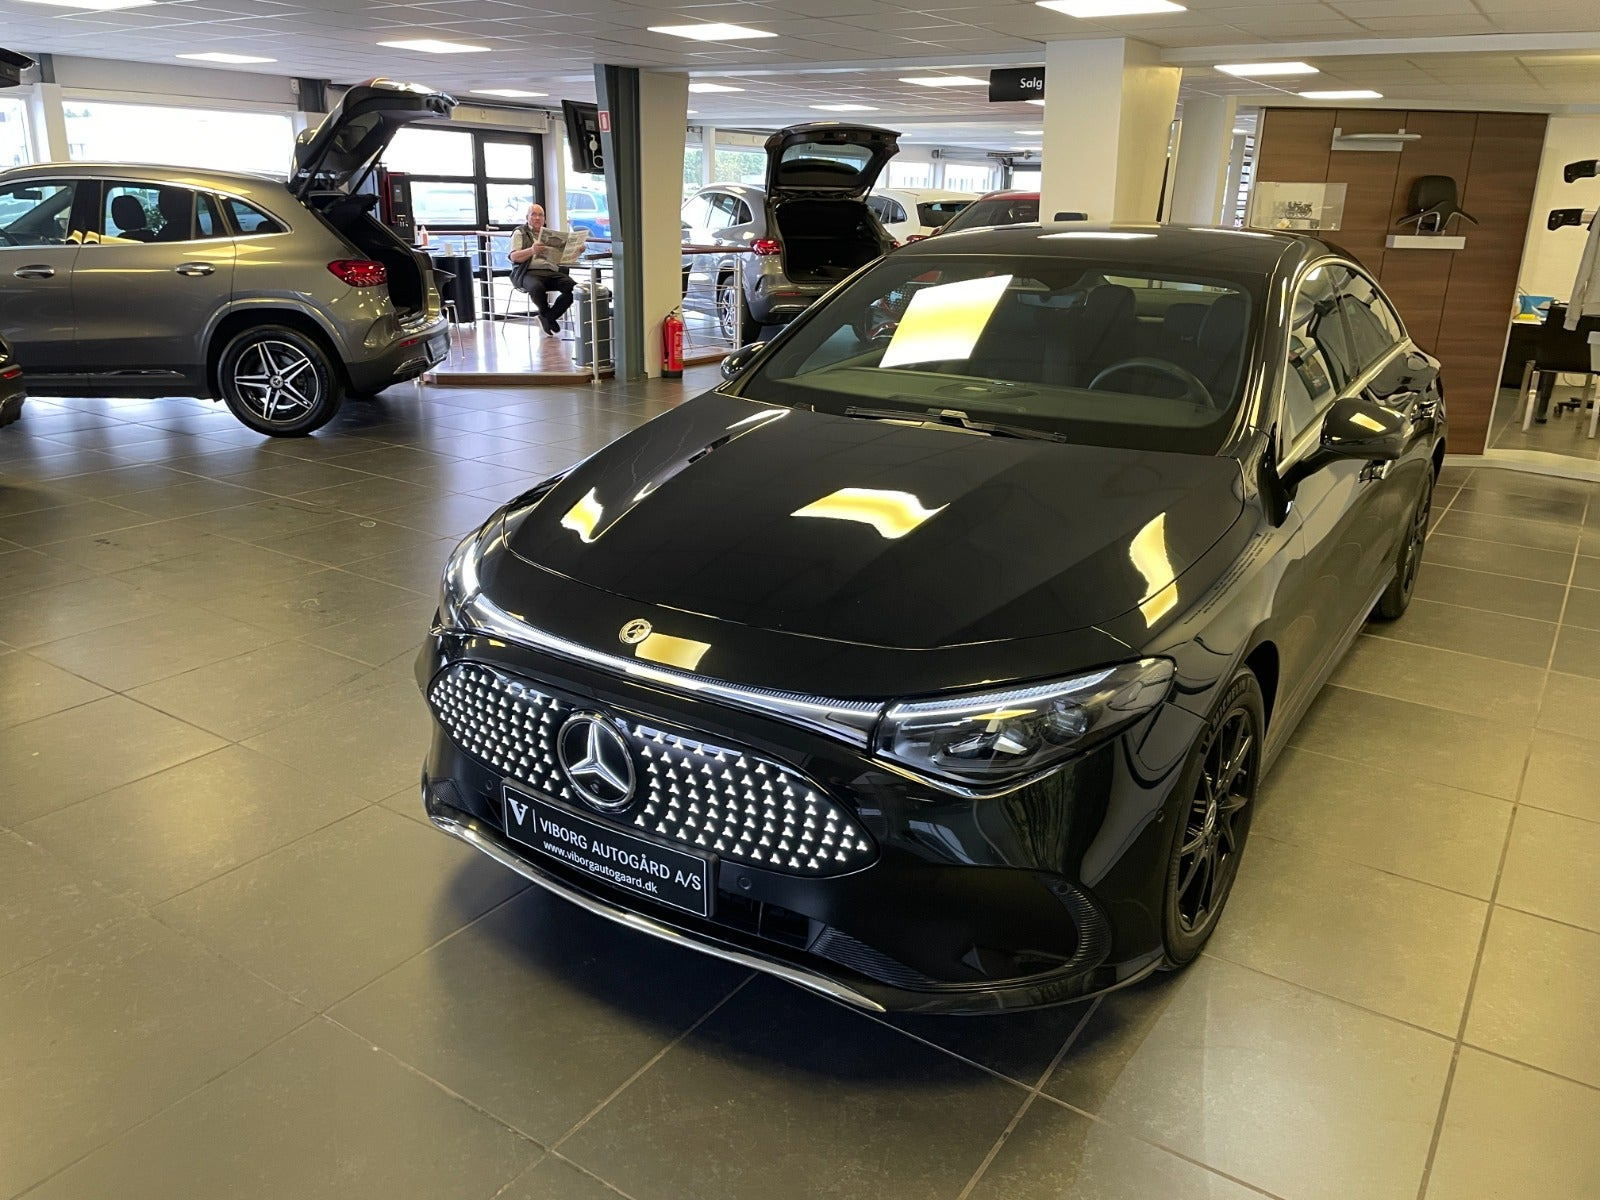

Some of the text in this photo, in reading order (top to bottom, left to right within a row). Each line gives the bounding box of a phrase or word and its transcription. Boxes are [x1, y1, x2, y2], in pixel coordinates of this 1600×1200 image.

[1020, 76, 1043, 90] Salg
[539, 817, 588, 850] VIBORG
[591, 840, 670, 880] AUTOGÅRD
[674, 870, 702, 891] A/S
[543, 840, 659, 895] www.viborgautogaard.dk
